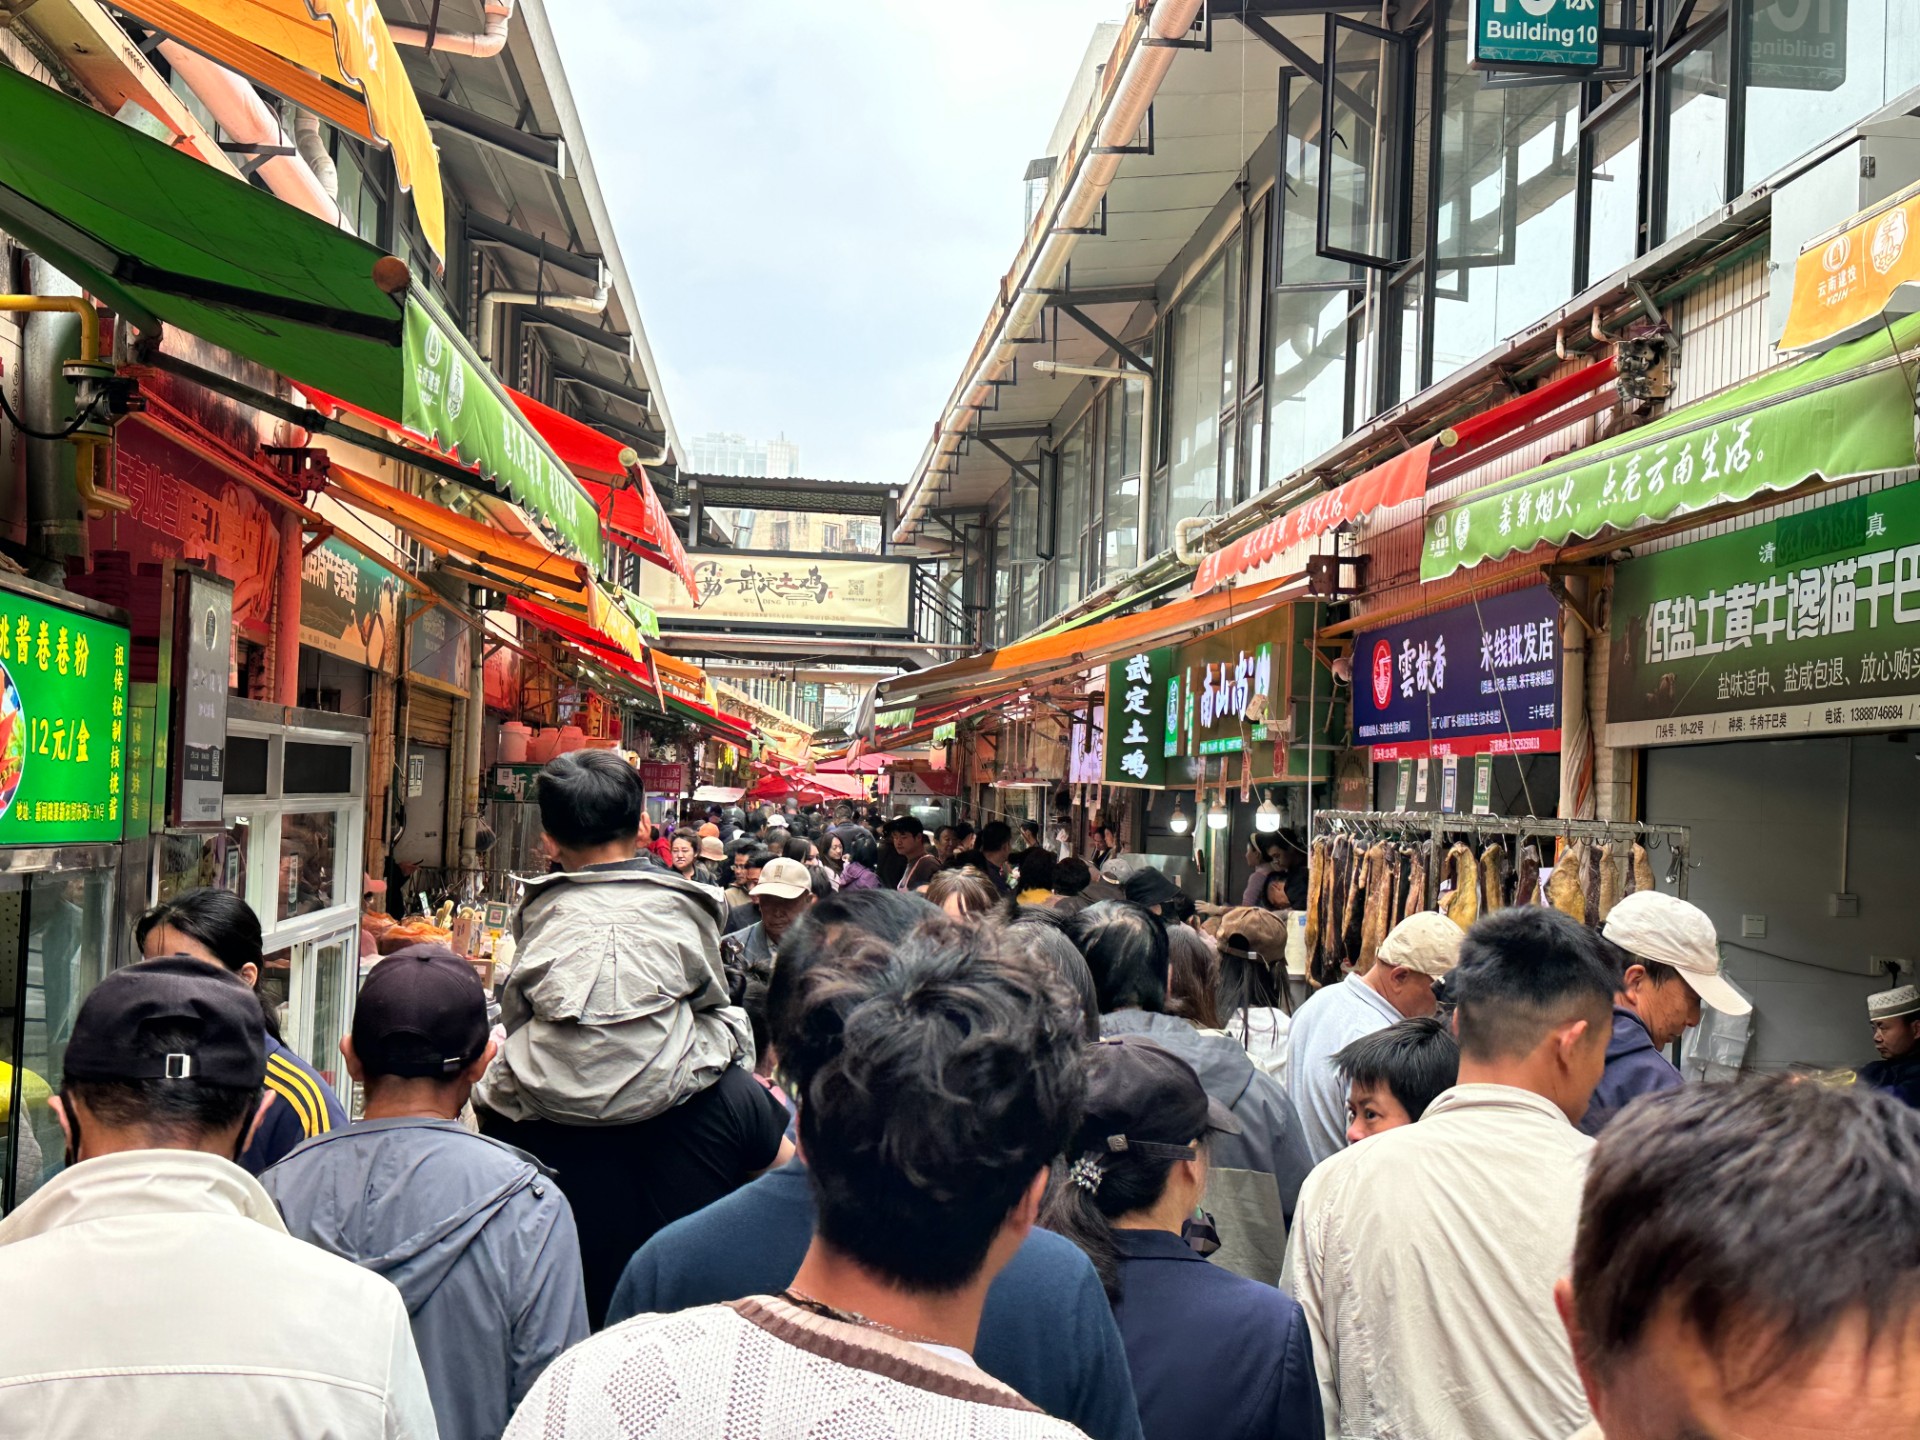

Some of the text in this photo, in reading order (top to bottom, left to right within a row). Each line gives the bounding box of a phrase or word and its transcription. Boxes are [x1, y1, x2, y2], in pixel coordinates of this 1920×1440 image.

[1758, 512, 1887, 564] 清 真
[1480, 617, 1555, 672] 米线批发店
[1119, 653, 1152, 780] 武定土鸡
